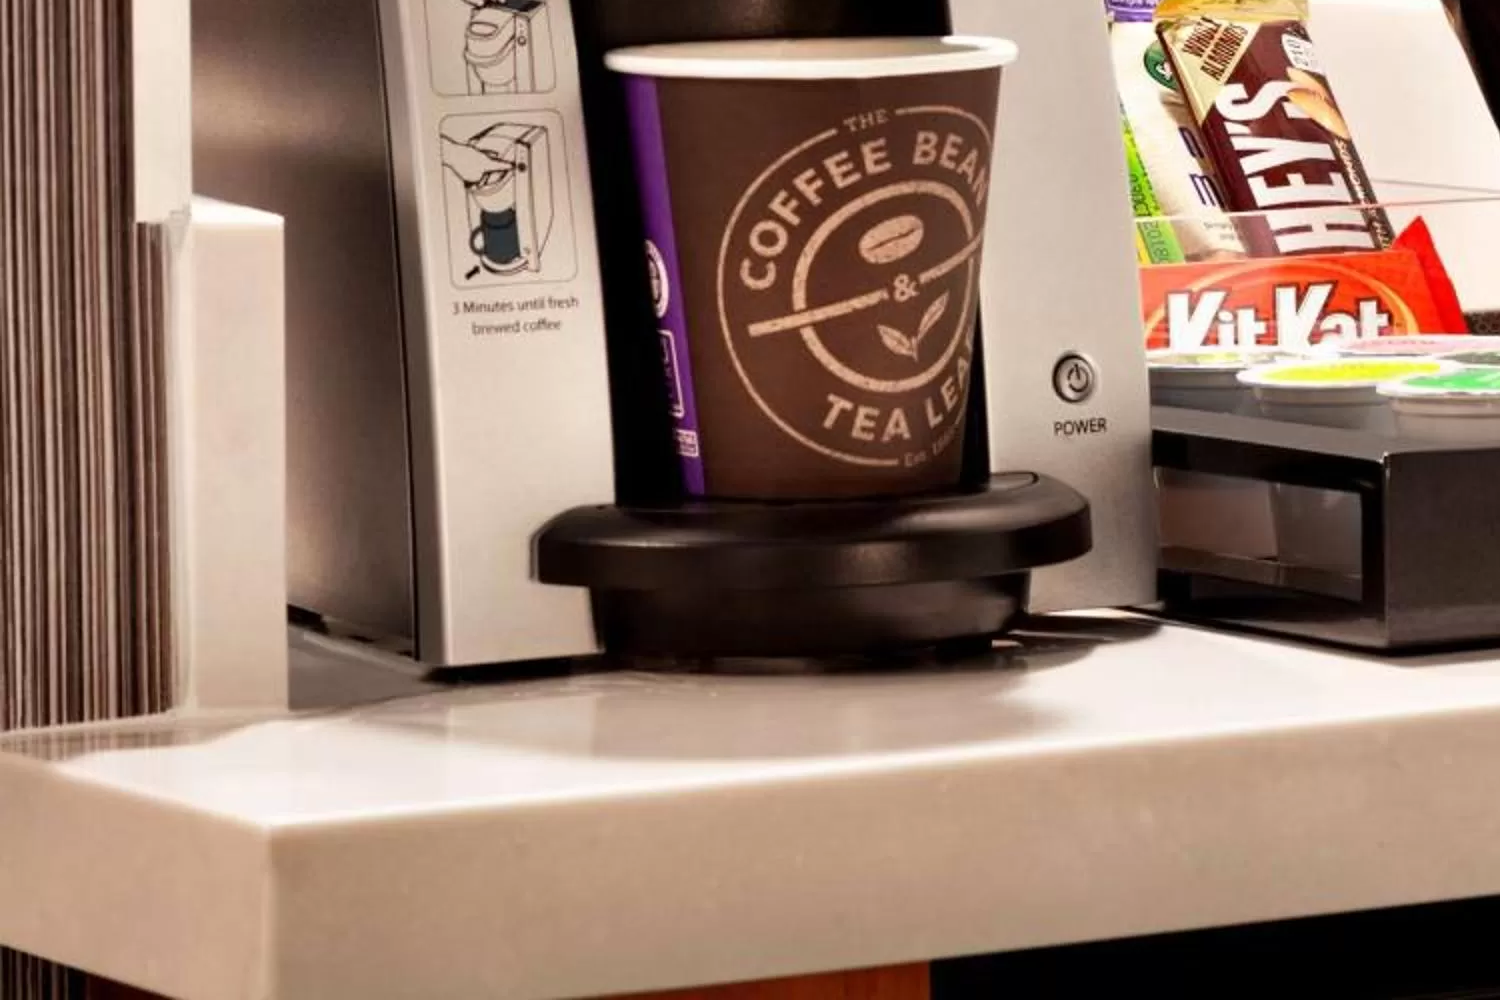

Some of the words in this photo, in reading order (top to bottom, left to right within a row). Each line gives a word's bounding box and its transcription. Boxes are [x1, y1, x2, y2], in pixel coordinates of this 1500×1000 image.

[843, 108, 890, 133] THE
[1215, 80, 1377, 254] HEY'S
[739, 138, 892, 291] COFFEE
[912, 130, 988, 208] BEAN
[893, 273, 920, 301] &
[451, 301, 460, 315] 3
[463, 301, 515, 313] Minutes
[517, 296, 545, 311] until
[547, 295, 580, 309] fresh
[1167, 290, 1269, 351] Kit
[1275, 282, 1391, 350] Kat
[471, 320, 520, 336] brewed
[522, 317, 562, 333] coffee
[822, 394, 912, 442] TEA
[1054, 417, 1107, 437] POWER
